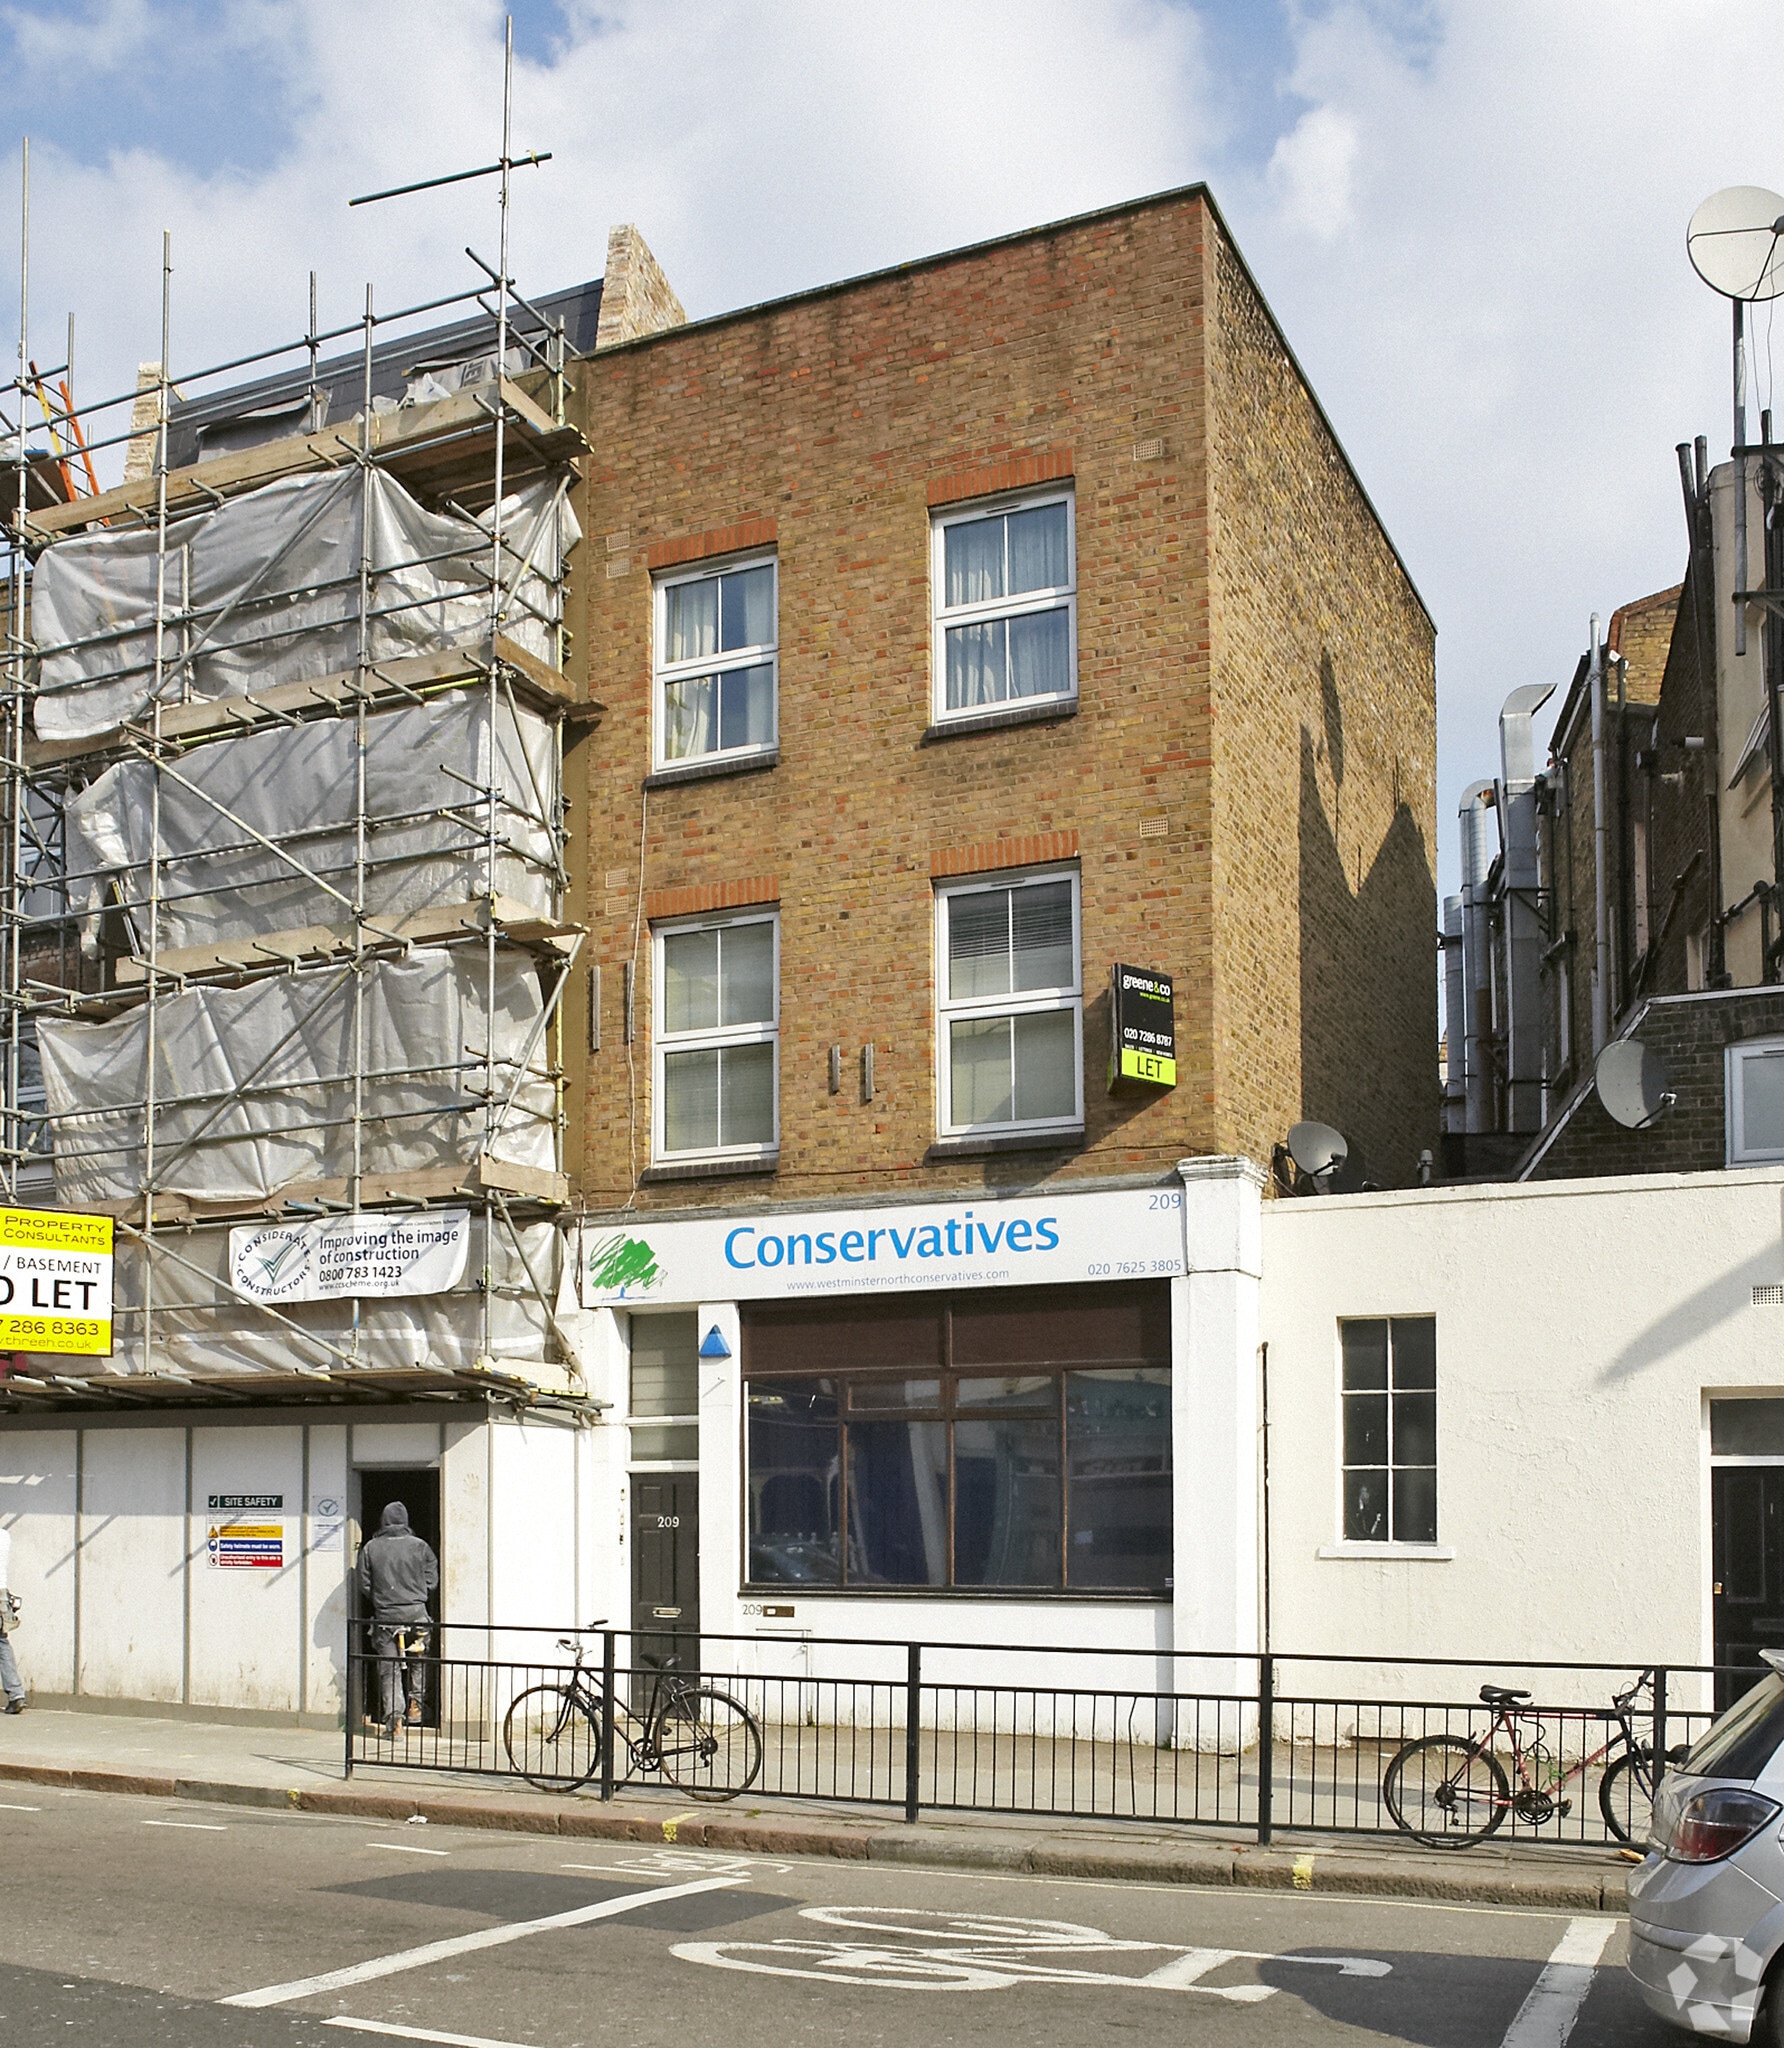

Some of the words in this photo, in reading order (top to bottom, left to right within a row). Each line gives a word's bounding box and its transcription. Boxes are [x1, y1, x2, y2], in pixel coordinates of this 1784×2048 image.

[1123, 974, 1171, 996] greene&co
[1124, 1027, 1138, 1040] 020
[1139, 1029, 1156, 1044] 7286
[1156, 1033, 1172, 1047] 8787
[1137, 1055, 1163, 1079] LET
[1149, 1193, 1182, 1210] 209
[5, 1215, 106, 1233] PROPERTY
[4, 1228, 106, 1246] CONSULTANTS
[238, 1230, 311, 1262] CONSIDERATE
[319, 1231, 388, 1251] Improving
[391, 1230, 414, 1245] the
[417, 1229, 459, 1246] image
[724, 1211, 1060, 1269] Conservatives
[319, 1250, 332, 1265] of
[334, 1246, 420, 1264] construction
[17, 1256, 102, 1275] BASEMENT
[319, 1267, 344, 1283] 0800
[346, 1266, 369, 1280] 783
[373, 1265, 402, 1278] 1423
[1087, 1263, 1111, 1276] 020
[1116, 1261, 1146, 1274] 7625
[1150, 1259, 1181, 1272] 3805
[236, 1265, 311, 1297] CONSTRUCTORS
[787, 1268, 1010, 1290] www.westminsternorthconservatives.com
[32, 1278, 98, 1311] LET
[10, 1320, 46, 1335] 286
[52, 1321, 99, 1336] 8363
[224, 1497, 243, 1507] SITE
[244, 1496, 278, 1507] SAFETY
[657, 1516, 680, 1528] 209
[742, 1604, 763, 1615] 209
